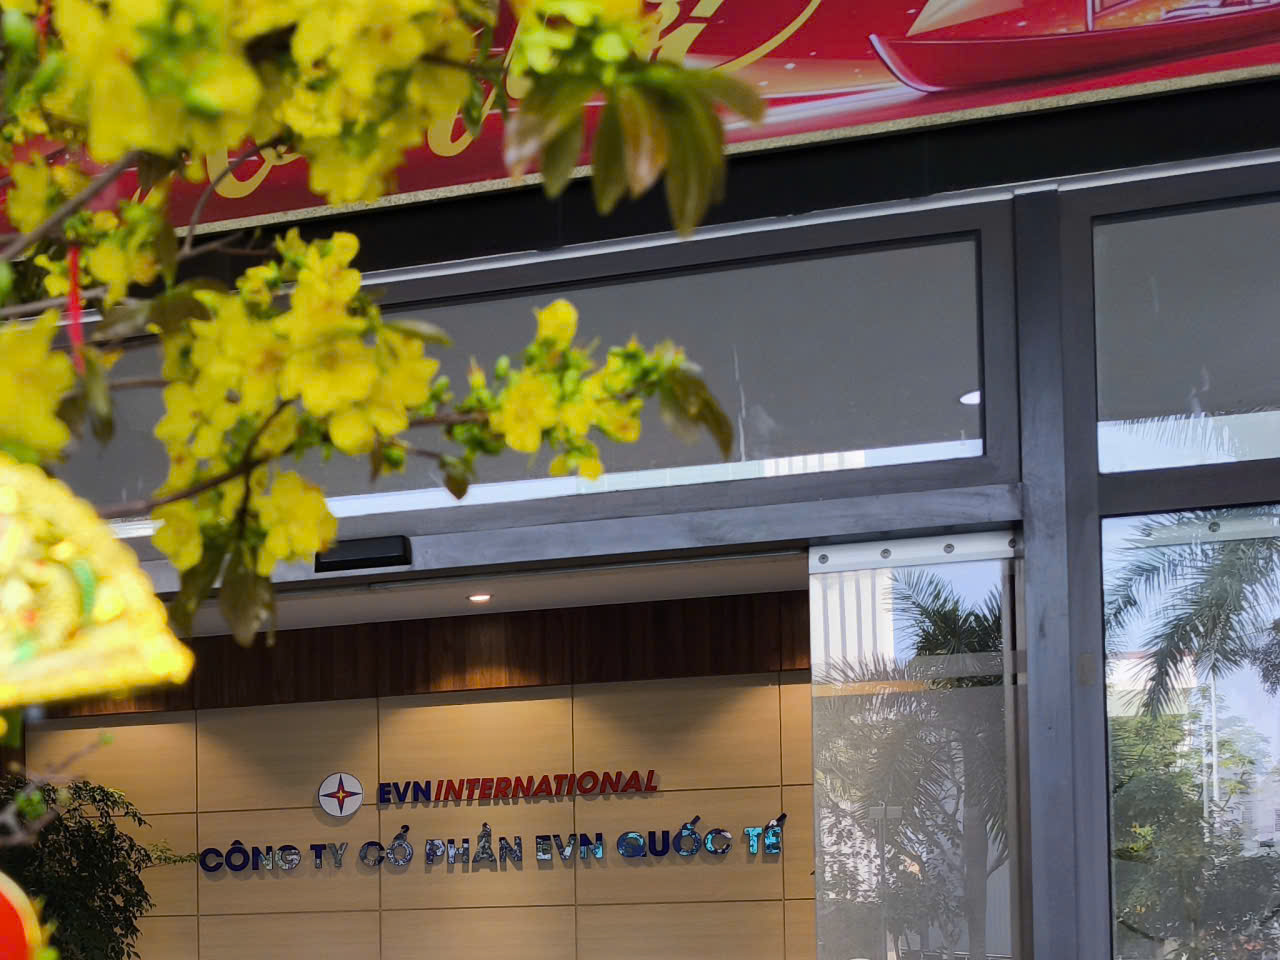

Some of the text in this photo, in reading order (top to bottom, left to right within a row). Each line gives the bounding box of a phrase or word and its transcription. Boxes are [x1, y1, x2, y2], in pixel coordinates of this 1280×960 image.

[199, 839, 302, 873] CÔNG
[310, 842, 349, 869] TY
[359, 824, 414, 867] CỔ
[535, 831, 604, 861] EVN
[616, 814, 733, 858] QUỐC
[743, 812, 788, 855] TẾ
